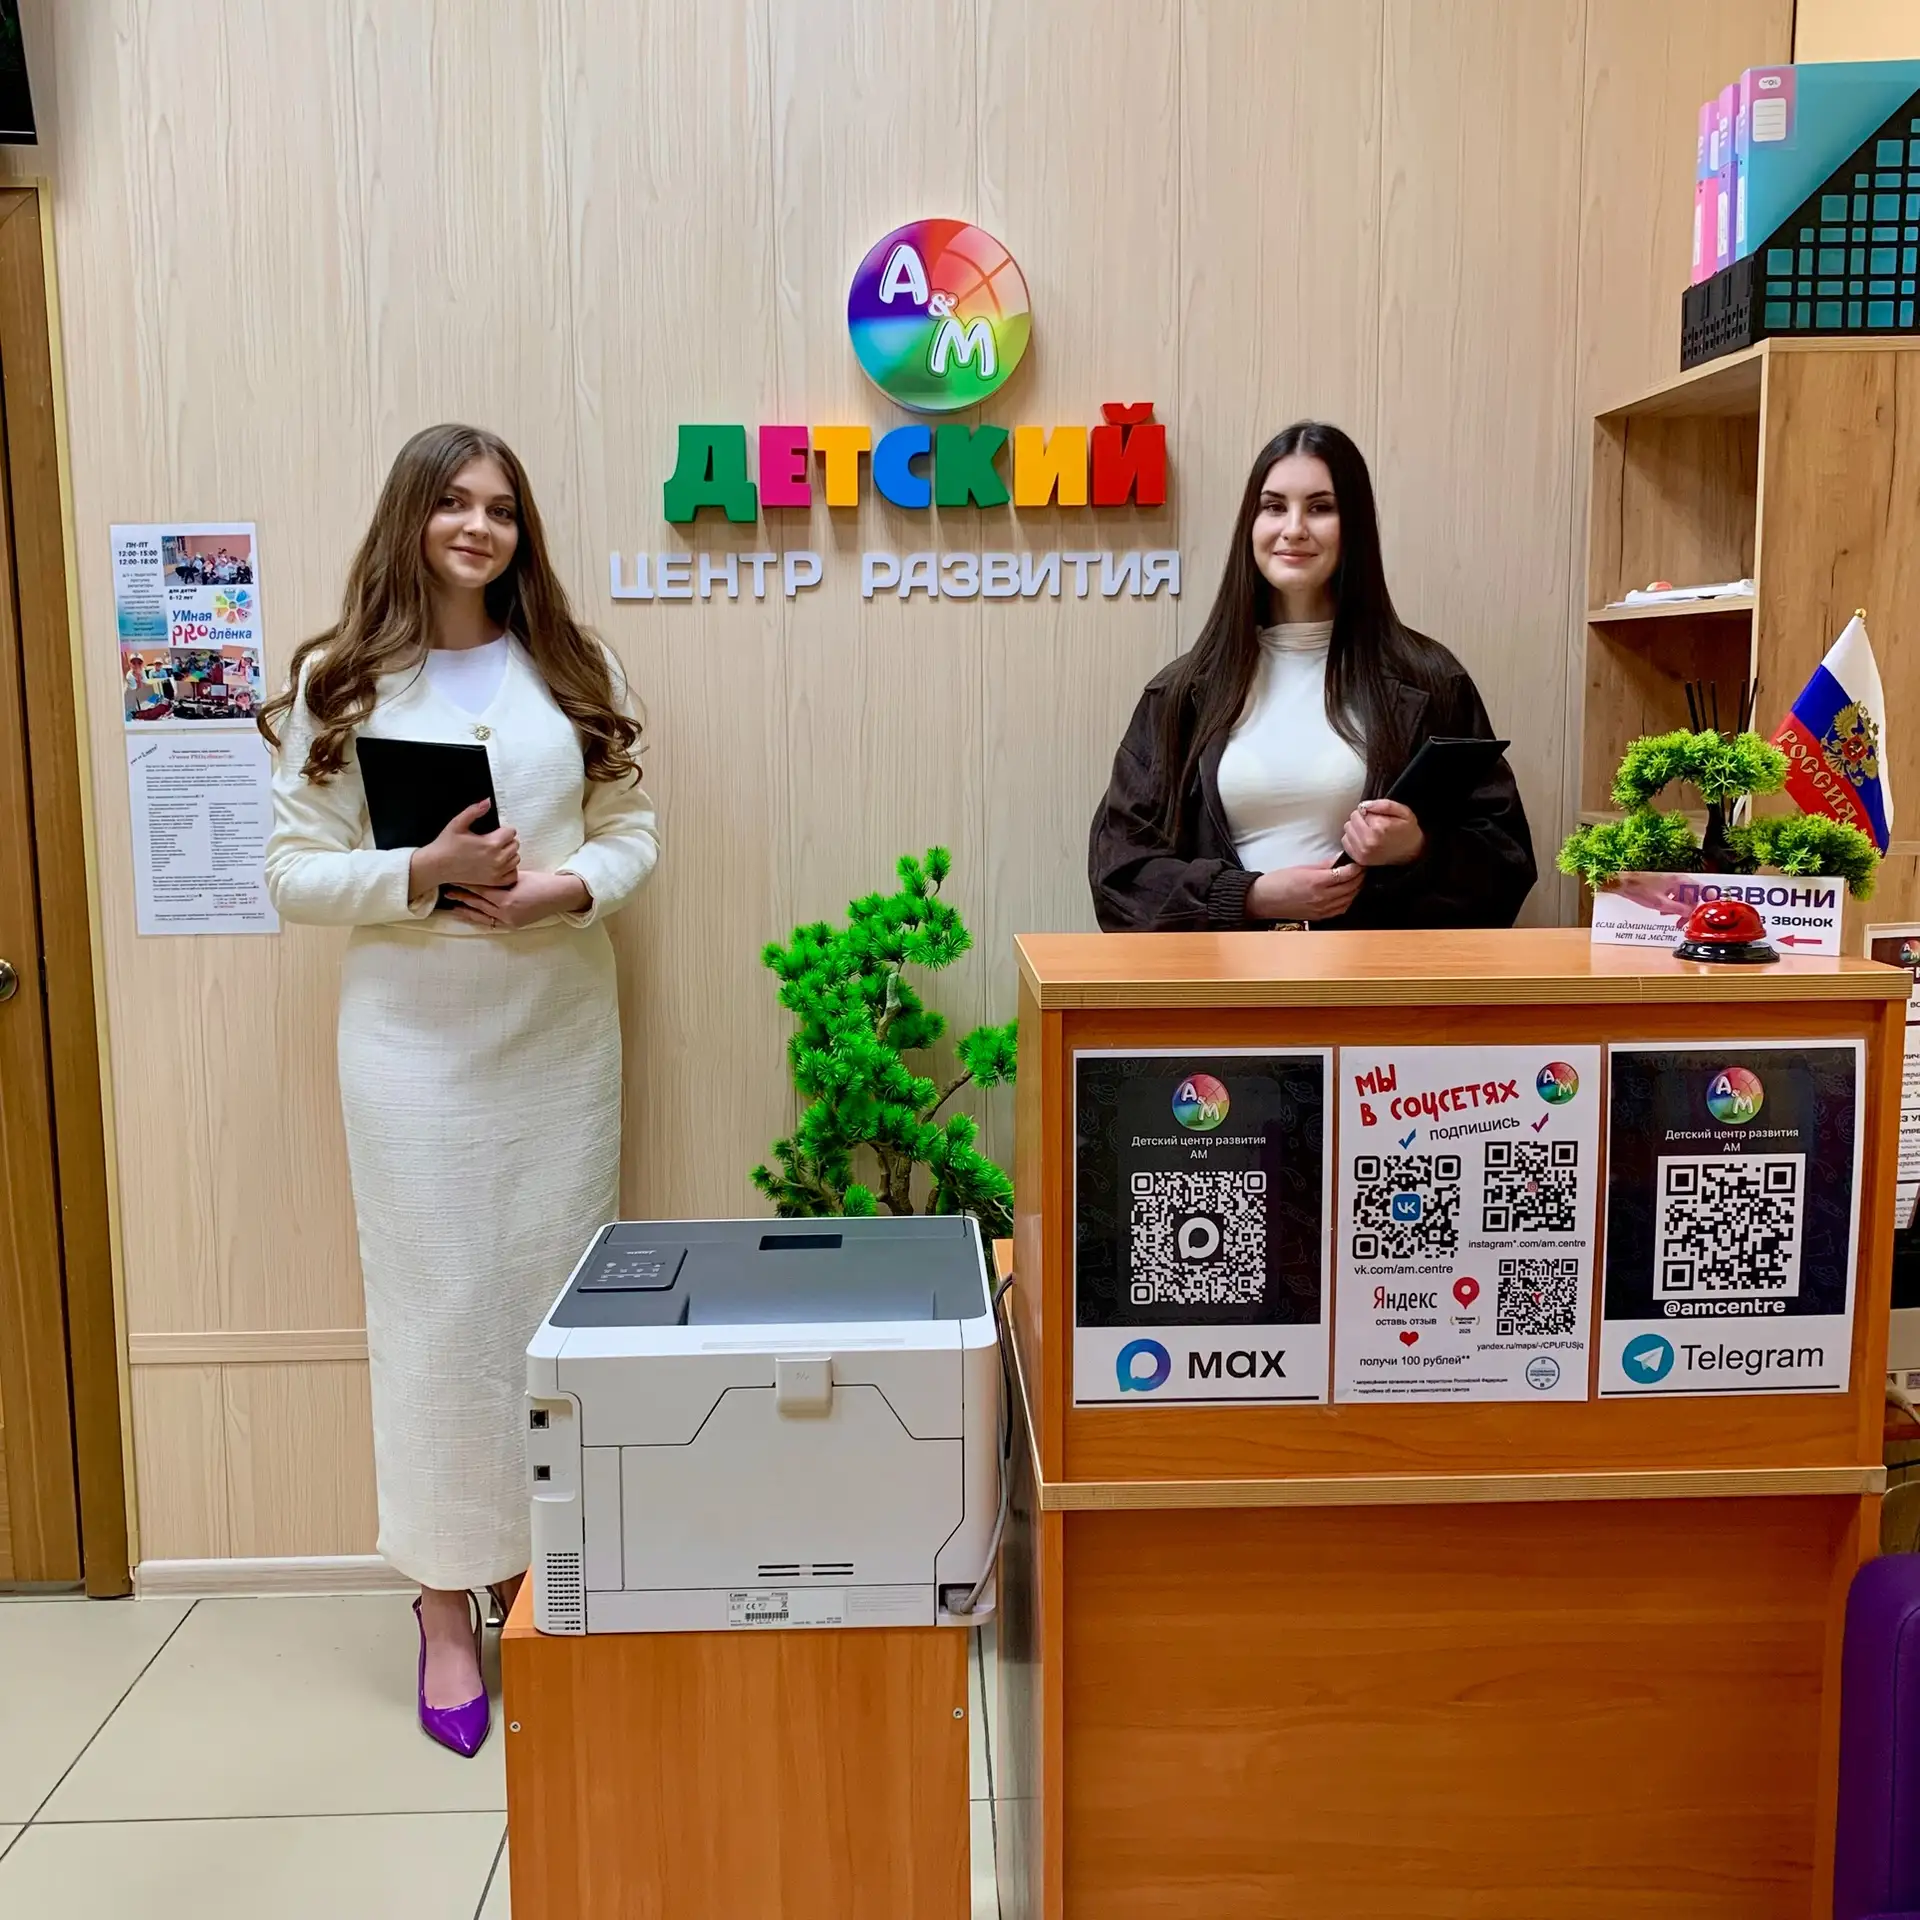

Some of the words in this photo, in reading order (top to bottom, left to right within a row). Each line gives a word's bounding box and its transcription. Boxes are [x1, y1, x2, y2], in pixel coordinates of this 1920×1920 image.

[664, 402, 1167, 524] ДЕТСКИЙ
[610, 551, 824, 600] ЦЕНТР
[863, 550, 1181, 599] РАЗВИТИЯ
[172, 609, 212, 622] УМная
[1775, 729, 1858, 823] РОССИЯ
[1647, 934, 1677, 942] месте
[1354, 1064, 1397, 1097] МЫ
[1360, 1103, 1377, 1126] В
[1390, 1079, 1520, 1122] СОЦСЕТЯХ
[1429, 1117, 1520, 1140] подпишись
[1665, 1129, 1711, 1141] Детский
[1713, 1130, 1746, 1141] центр
[1748, 1128, 1799, 1140] развития
[1131, 1135, 1178, 1147] Детский
[1180, 1137, 1213, 1147] центр
[1215, 1136, 1266, 1148] развития
[1354, 1264, 1453, 1275] vk.com/am.centre
[1373, 1286, 1438, 1311] Яндекс
[1663, 1298, 1786, 1317] @amcentre
[1375, 1318, 1407, 1326] оставь
[1360, 1357, 1397, 1368] получи
[1401, 1356, 1420, 1366] 100
[1680, 1343, 1824, 1376] Telegram
